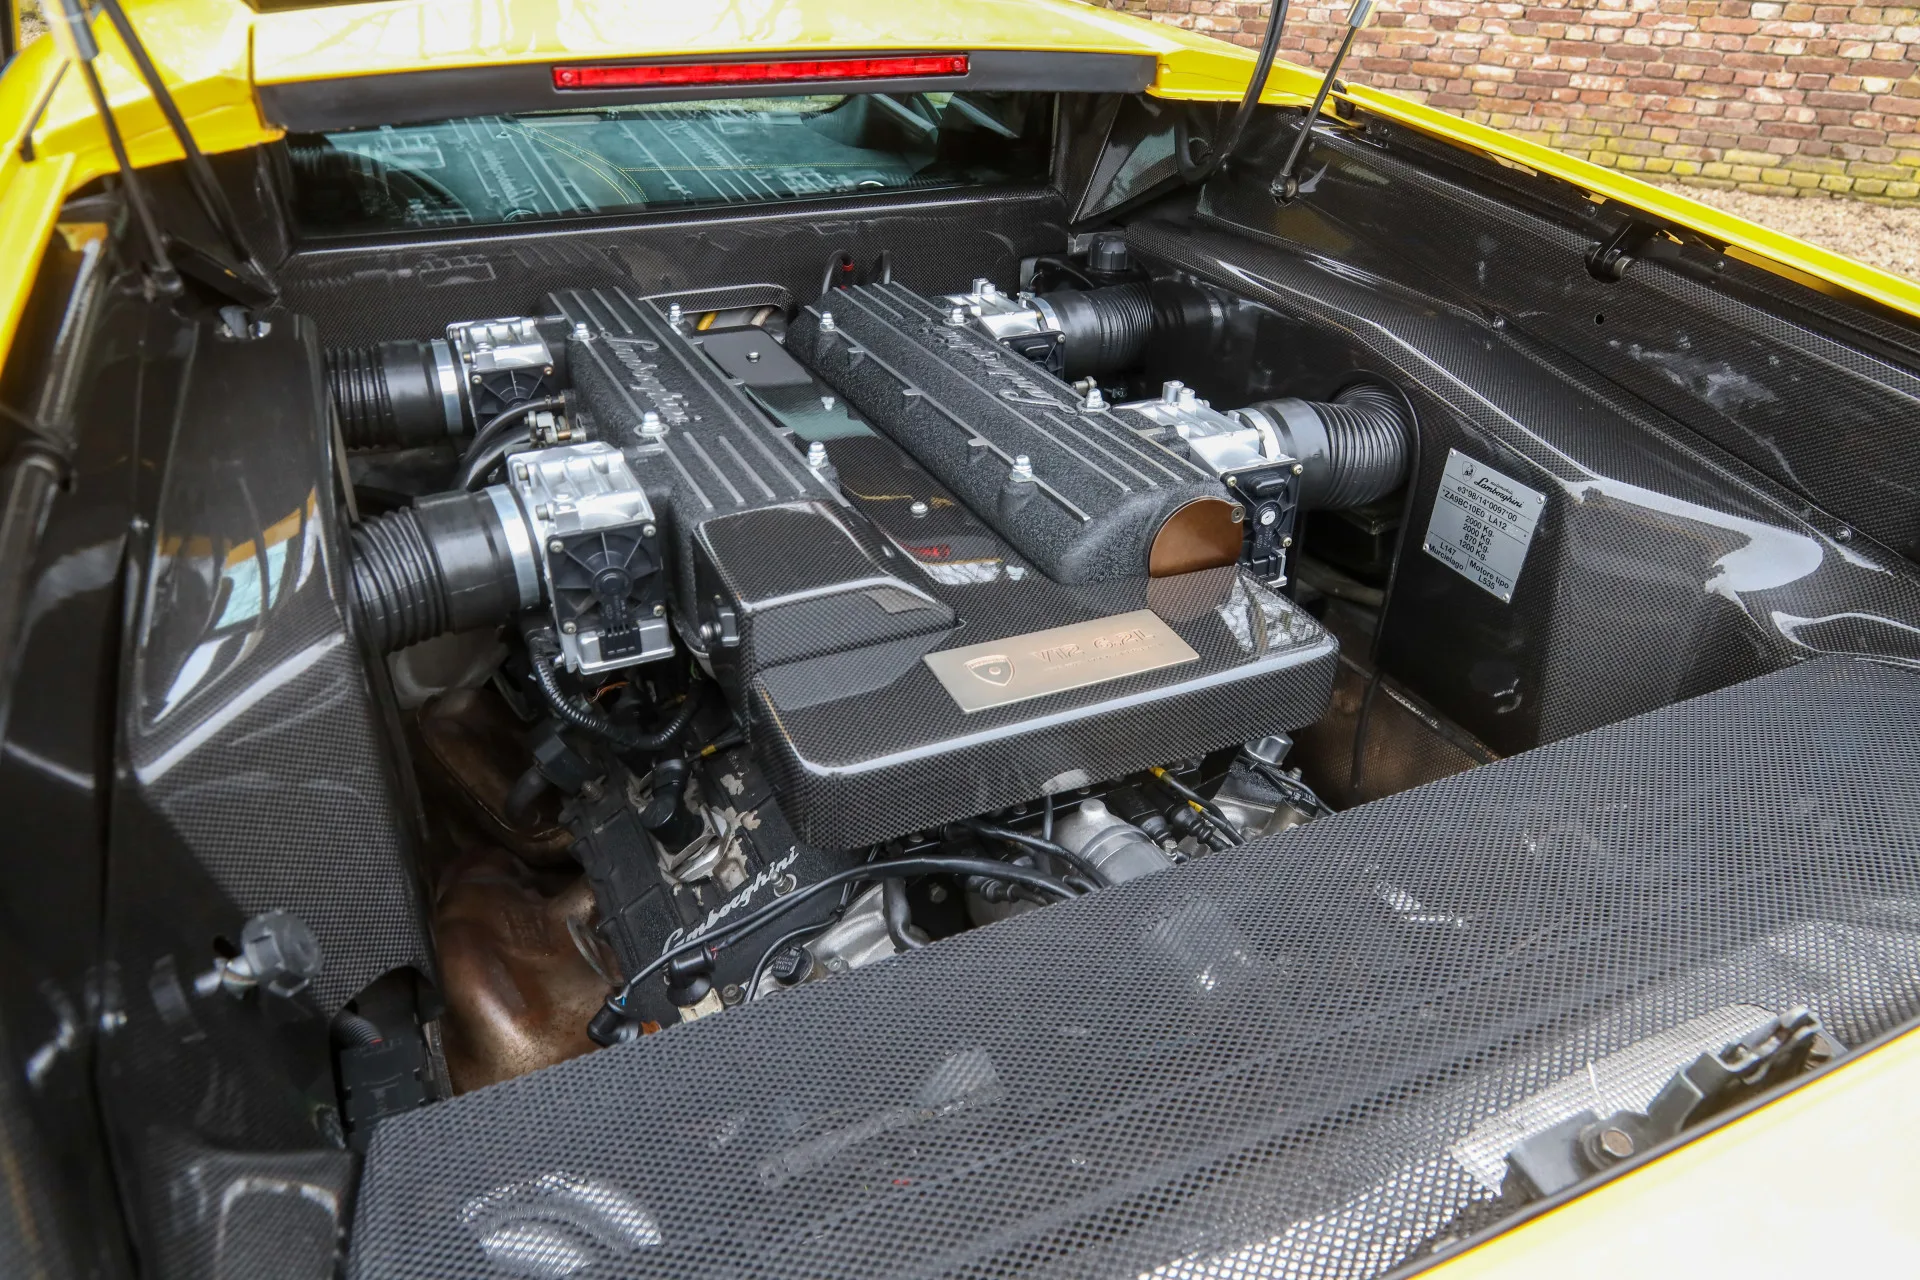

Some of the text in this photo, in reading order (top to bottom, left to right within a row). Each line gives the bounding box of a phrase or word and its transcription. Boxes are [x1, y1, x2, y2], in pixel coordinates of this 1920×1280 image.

[1474, 477, 1525, 508] Lamborghini
[1465, 515, 1495, 538] 2000 Kg.
[1488, 515, 1507, 531] LA12
[1462, 523, 1492, 546] 2000 Kg.
[1464, 533, 1489, 554] 870 Kg.
[1428, 543, 1464, 571] Murcielago
[1440, 542, 1457, 556] L147
[1459, 539, 1487, 561] 1200 Kg.
[1469, 560, 1510, 589] Motore tipo
[1478, 575, 1495, 590] L535
[1029, 643, 1085, 663] V12
